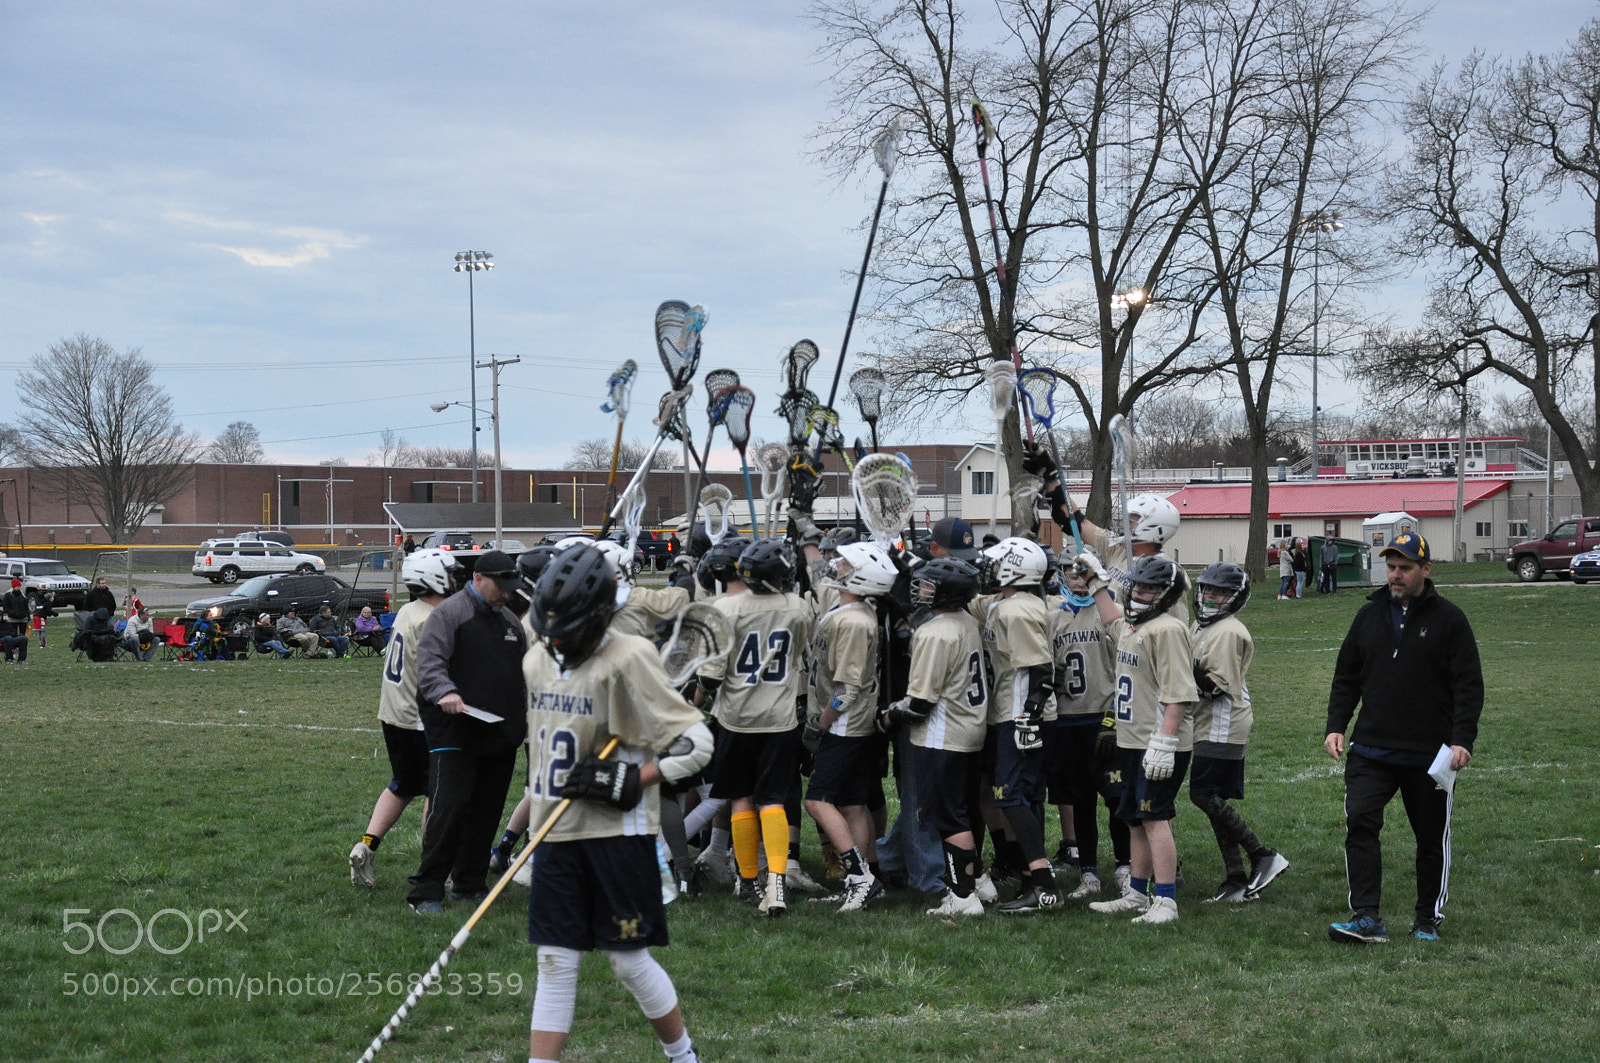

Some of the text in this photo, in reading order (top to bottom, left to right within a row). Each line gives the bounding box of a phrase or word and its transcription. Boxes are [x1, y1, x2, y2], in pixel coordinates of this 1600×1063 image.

[1371, 462, 1409, 471] VICKSBU
[734, 629, 793, 686] 43
[1065, 651, 1088, 697] 3
[532, 725, 579, 801] 12
